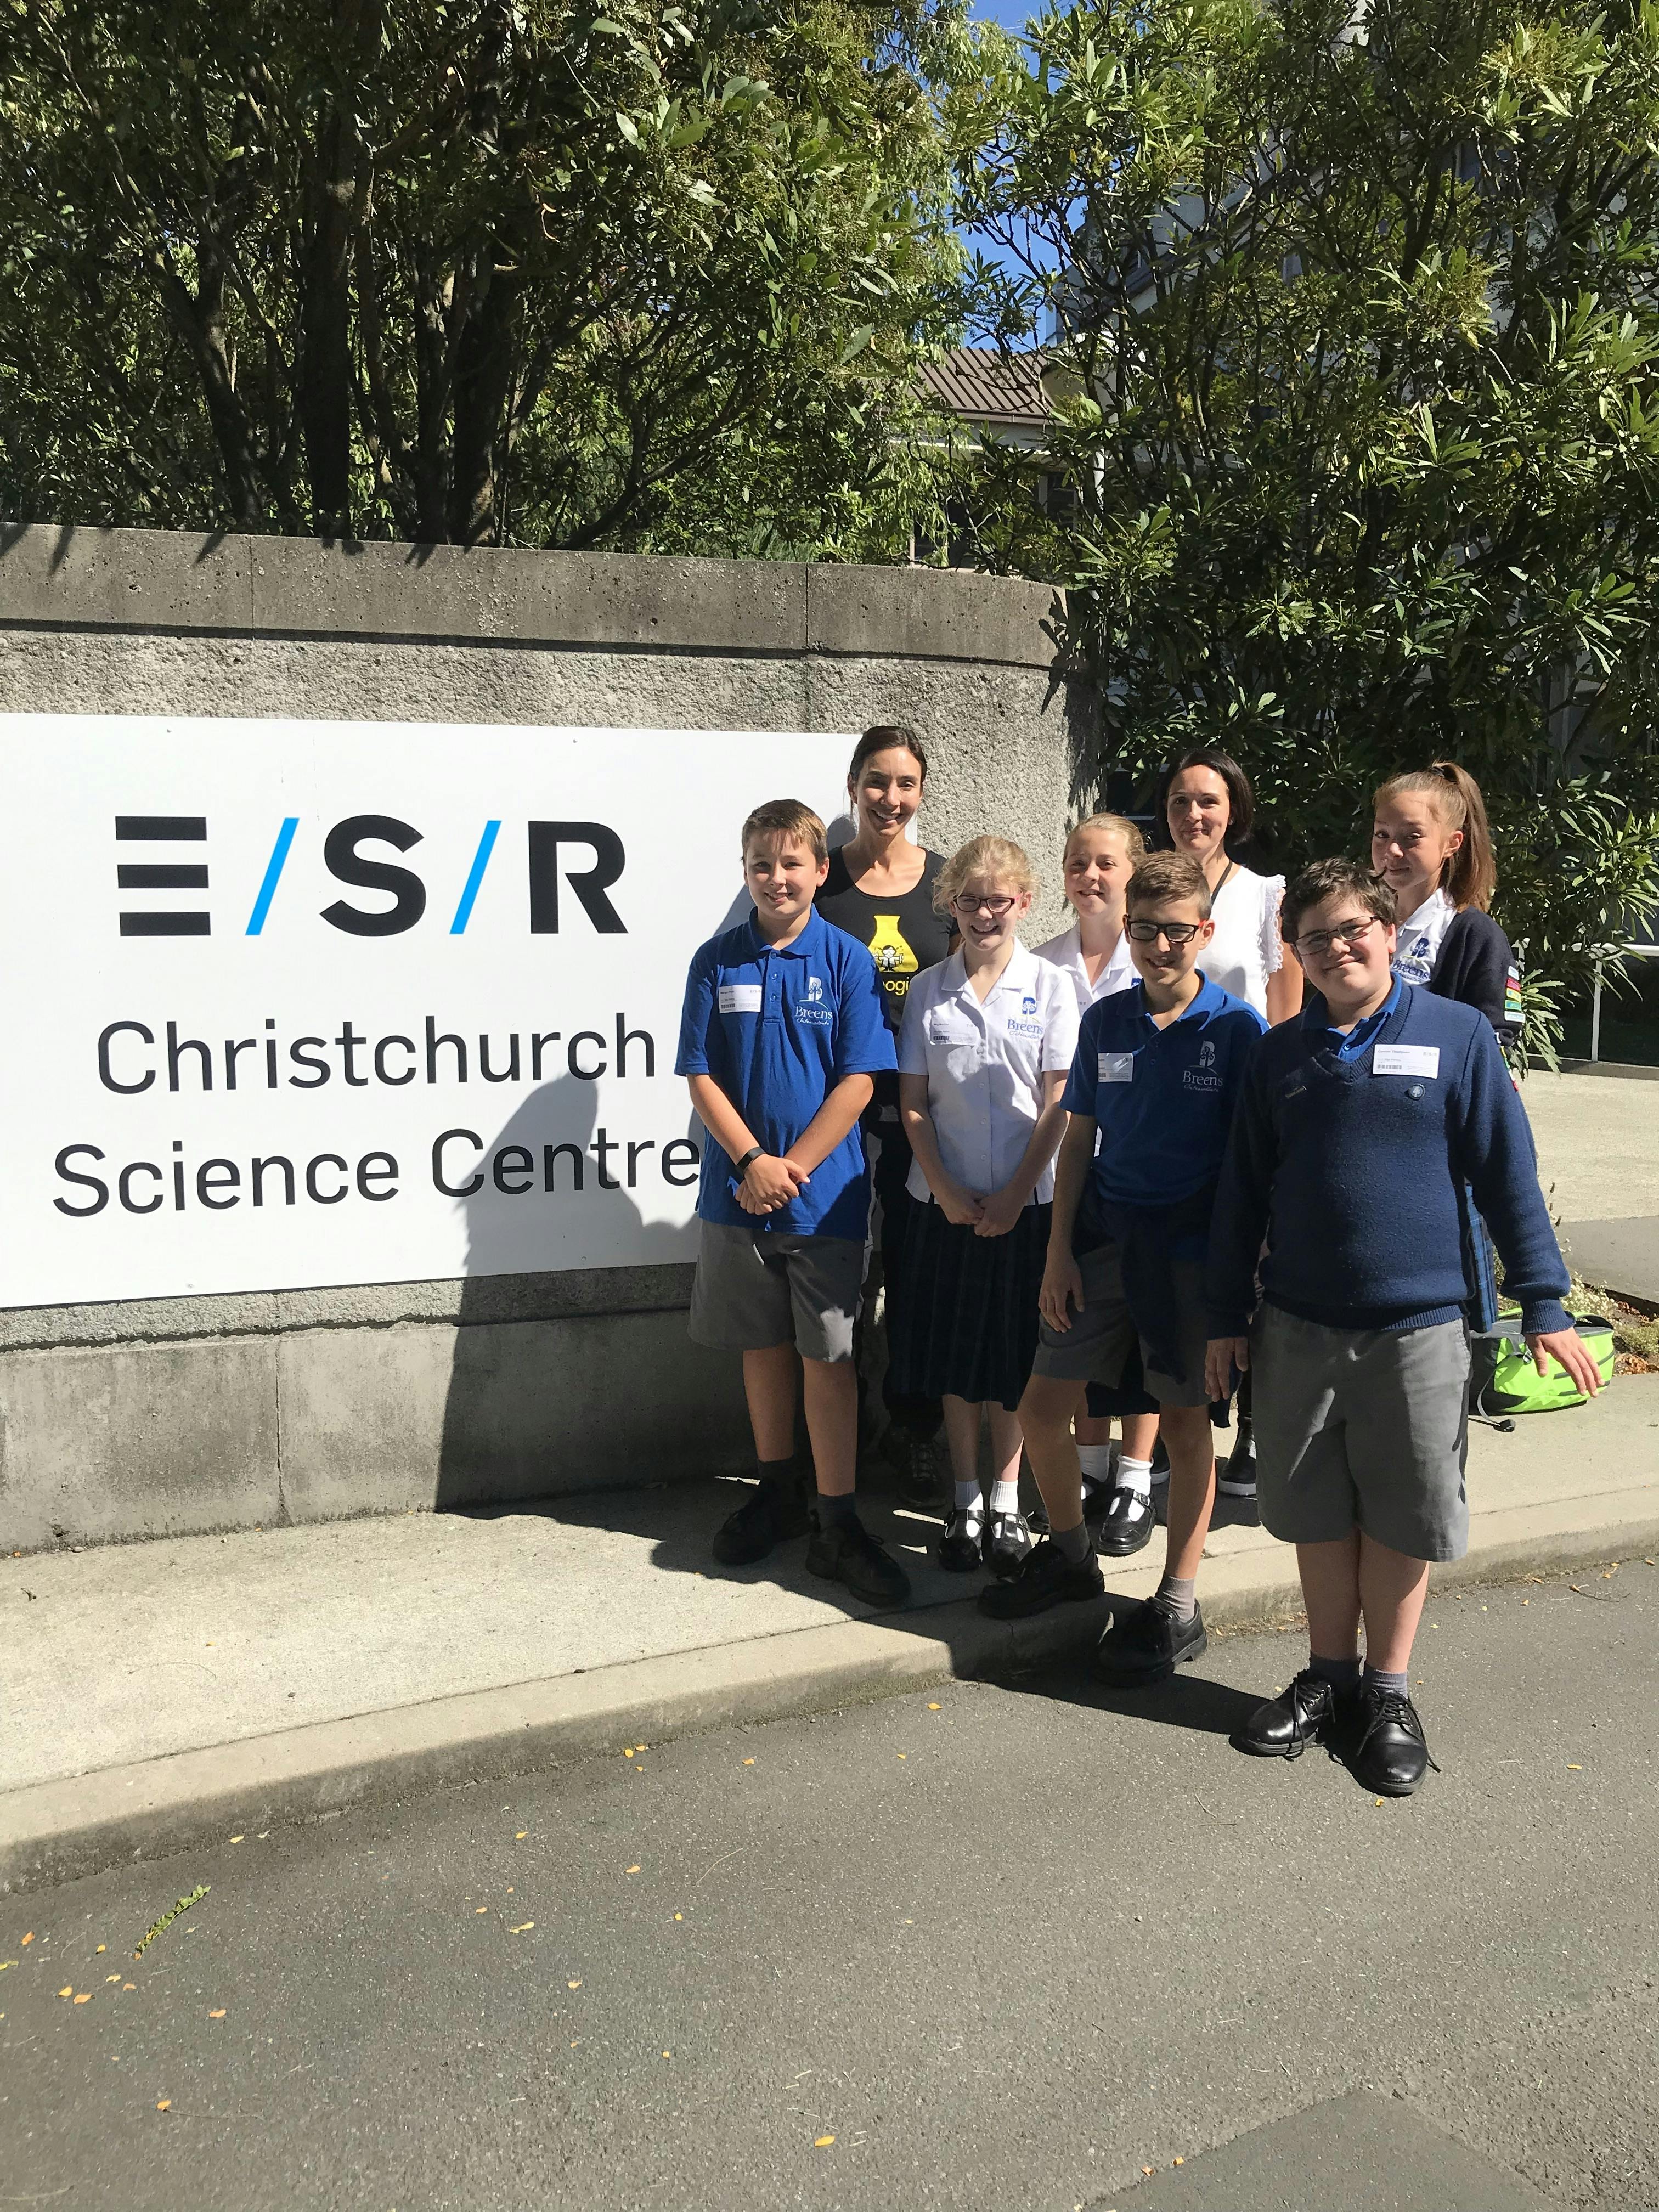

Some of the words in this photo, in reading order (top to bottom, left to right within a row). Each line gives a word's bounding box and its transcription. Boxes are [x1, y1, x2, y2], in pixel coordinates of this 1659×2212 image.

[1393, 959, 1431, 980] Breens
[794, 1006, 833, 1019] Breens
[1007, 1019, 1044, 1035] Breens
[98, 1012, 654, 1094] Christchurch
[1182, 1070, 1223, 1086] Breens
[53, 1141, 399, 1217] Science
[432, 1128, 699, 1198] Centre
